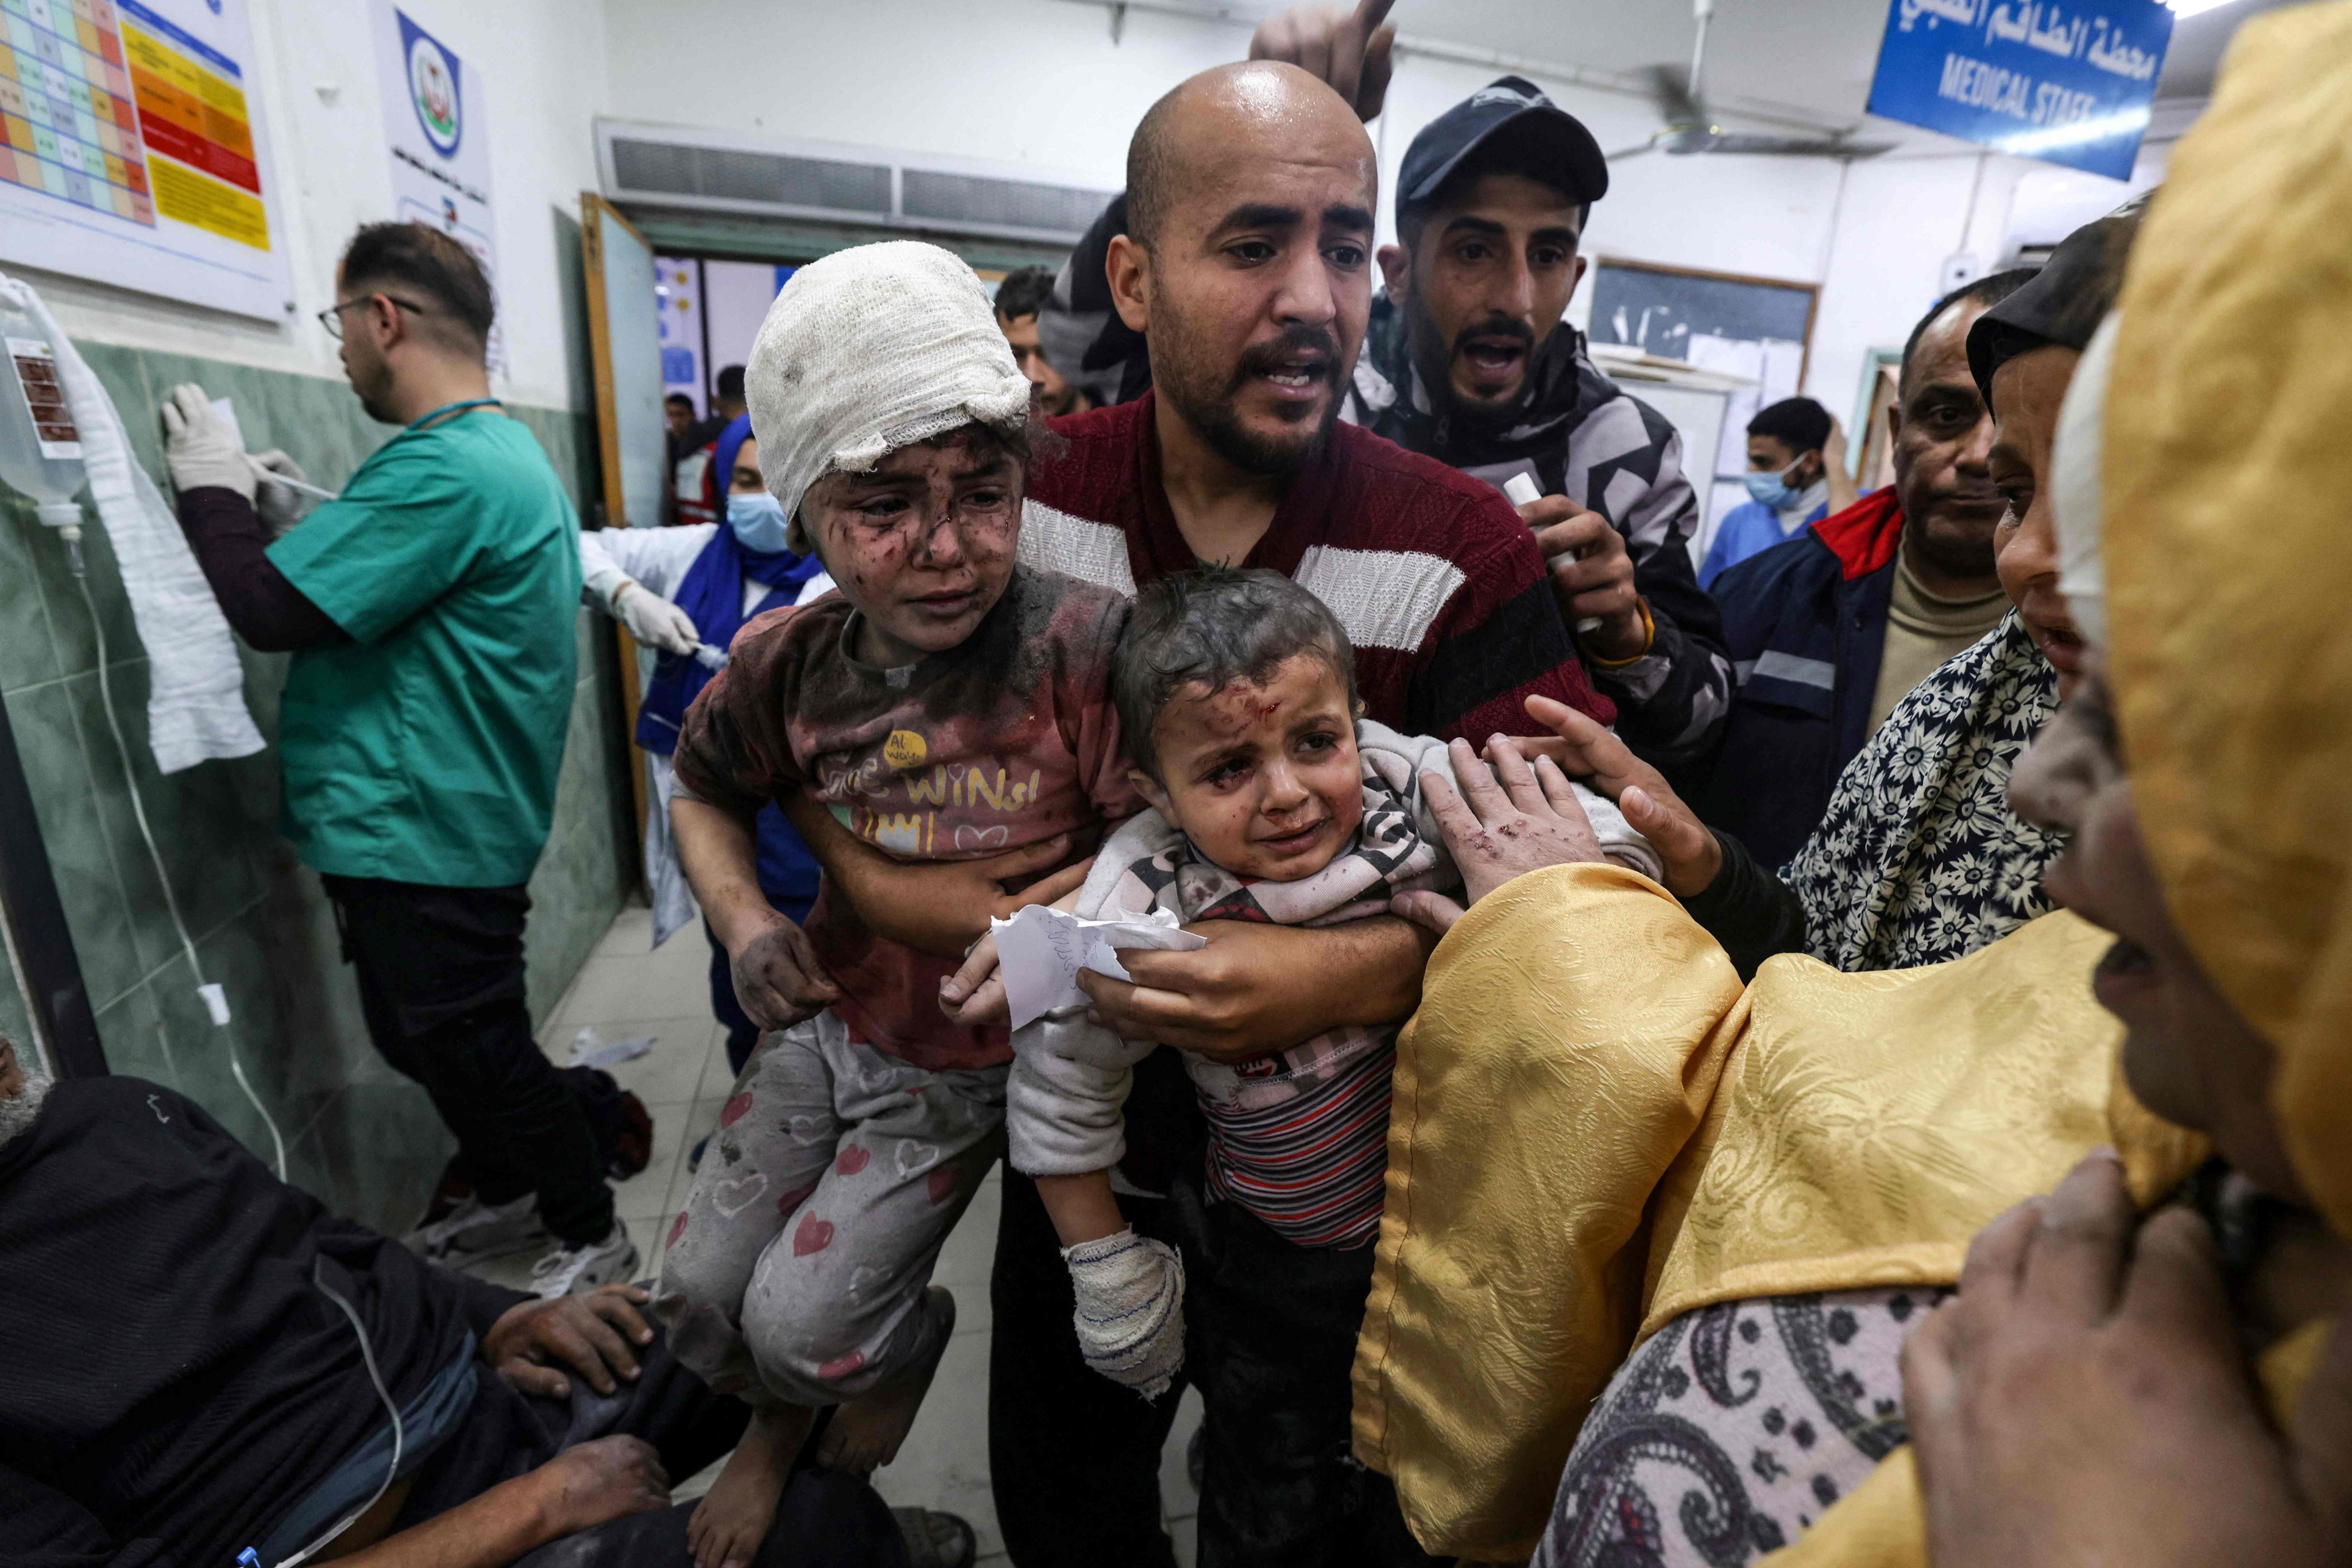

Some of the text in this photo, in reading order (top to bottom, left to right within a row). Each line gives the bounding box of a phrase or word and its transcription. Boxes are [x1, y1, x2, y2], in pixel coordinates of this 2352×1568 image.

[1984, 0, 2090, 58] الطاقم
[2087, 16, 2157, 80] محطة
[1938, 52, 2032, 118] MEDICAL
